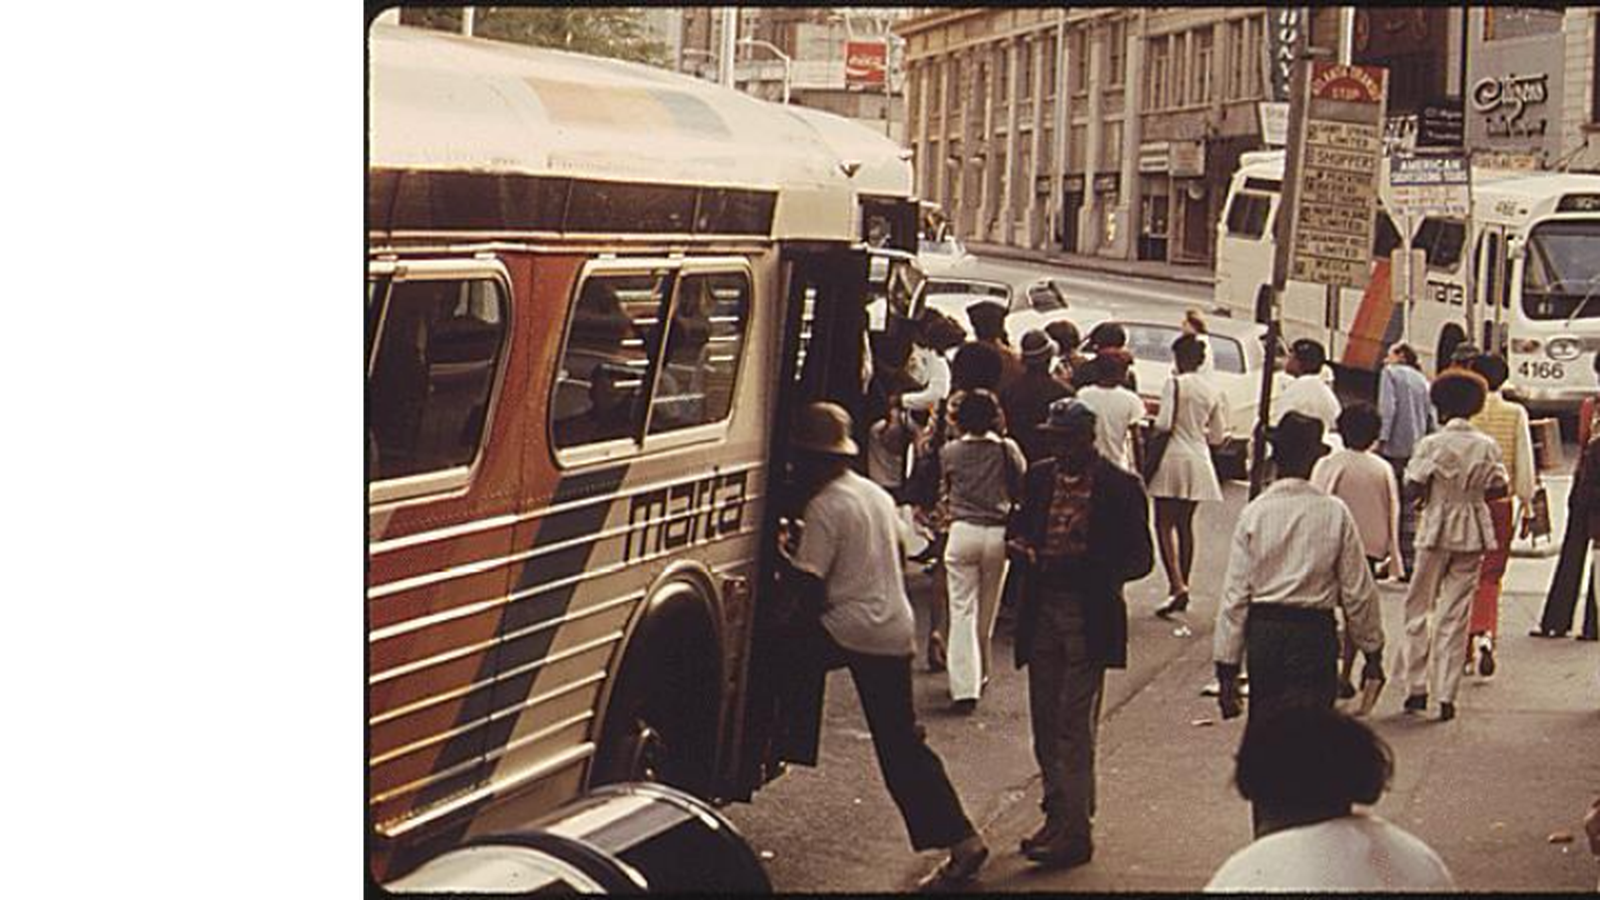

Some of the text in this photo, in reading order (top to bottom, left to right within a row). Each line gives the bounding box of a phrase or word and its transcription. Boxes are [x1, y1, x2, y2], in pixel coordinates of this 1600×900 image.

[1332, 87, 1360, 99] STOP
[1318, 150, 1375, 167] SHOPPERS
[1400, 158, 1461, 169] AMERICAN
[1518, 362, 1565, 379] 4166
[622, 466, 748, 563] marta
